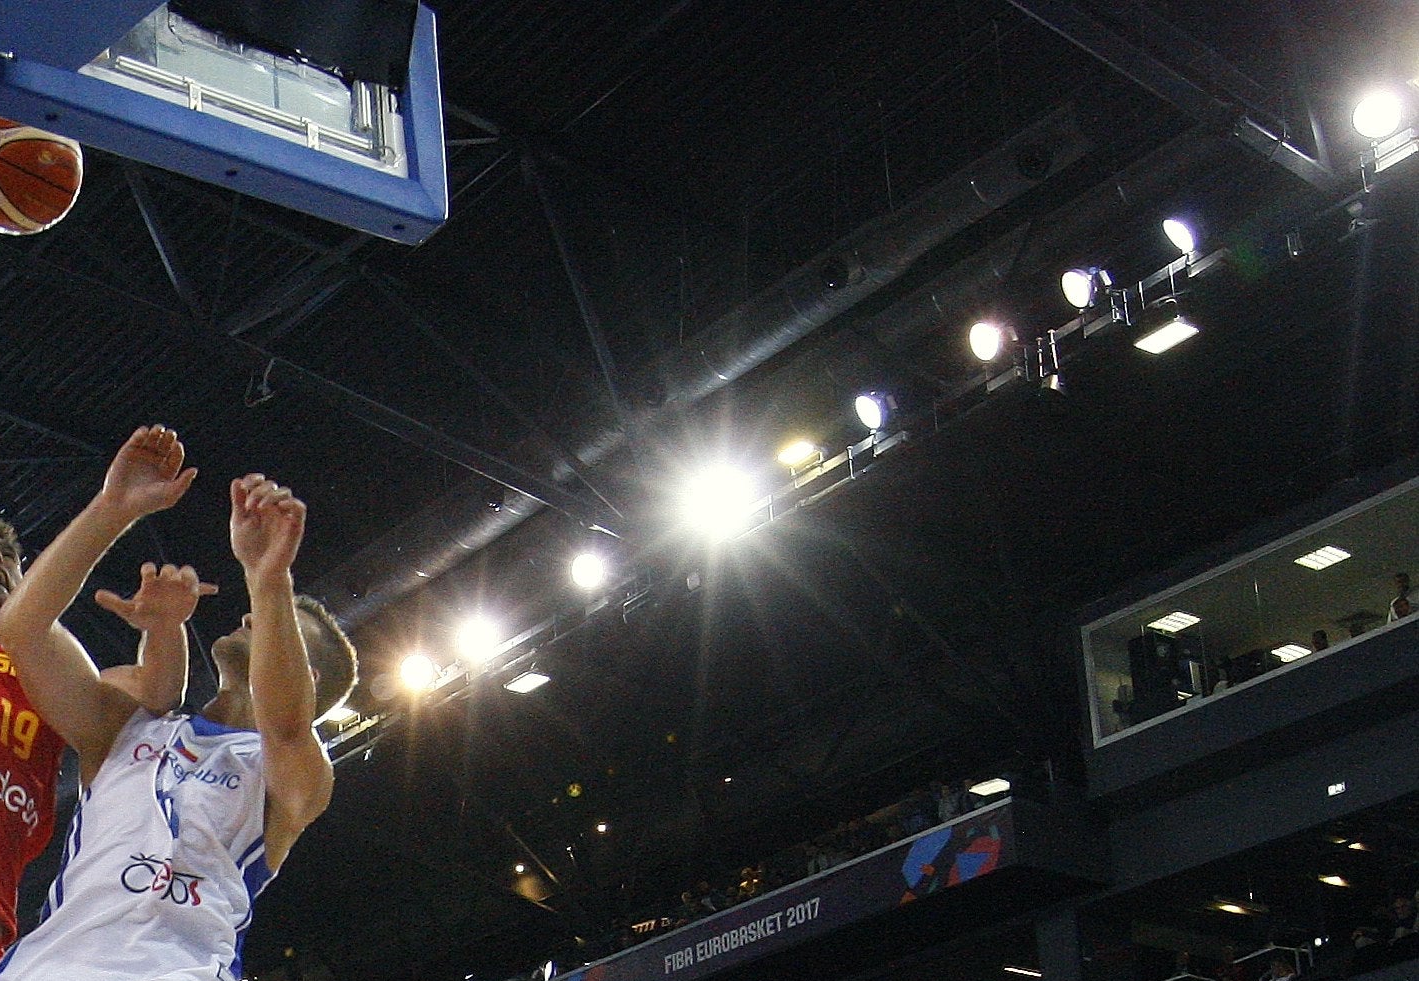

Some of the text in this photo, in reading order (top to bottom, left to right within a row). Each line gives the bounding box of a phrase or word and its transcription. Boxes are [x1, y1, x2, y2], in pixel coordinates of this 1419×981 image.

[0, 697, 39, 760] 19
[664, 897, 821, 974] FIBA EUROBASKET 2017
